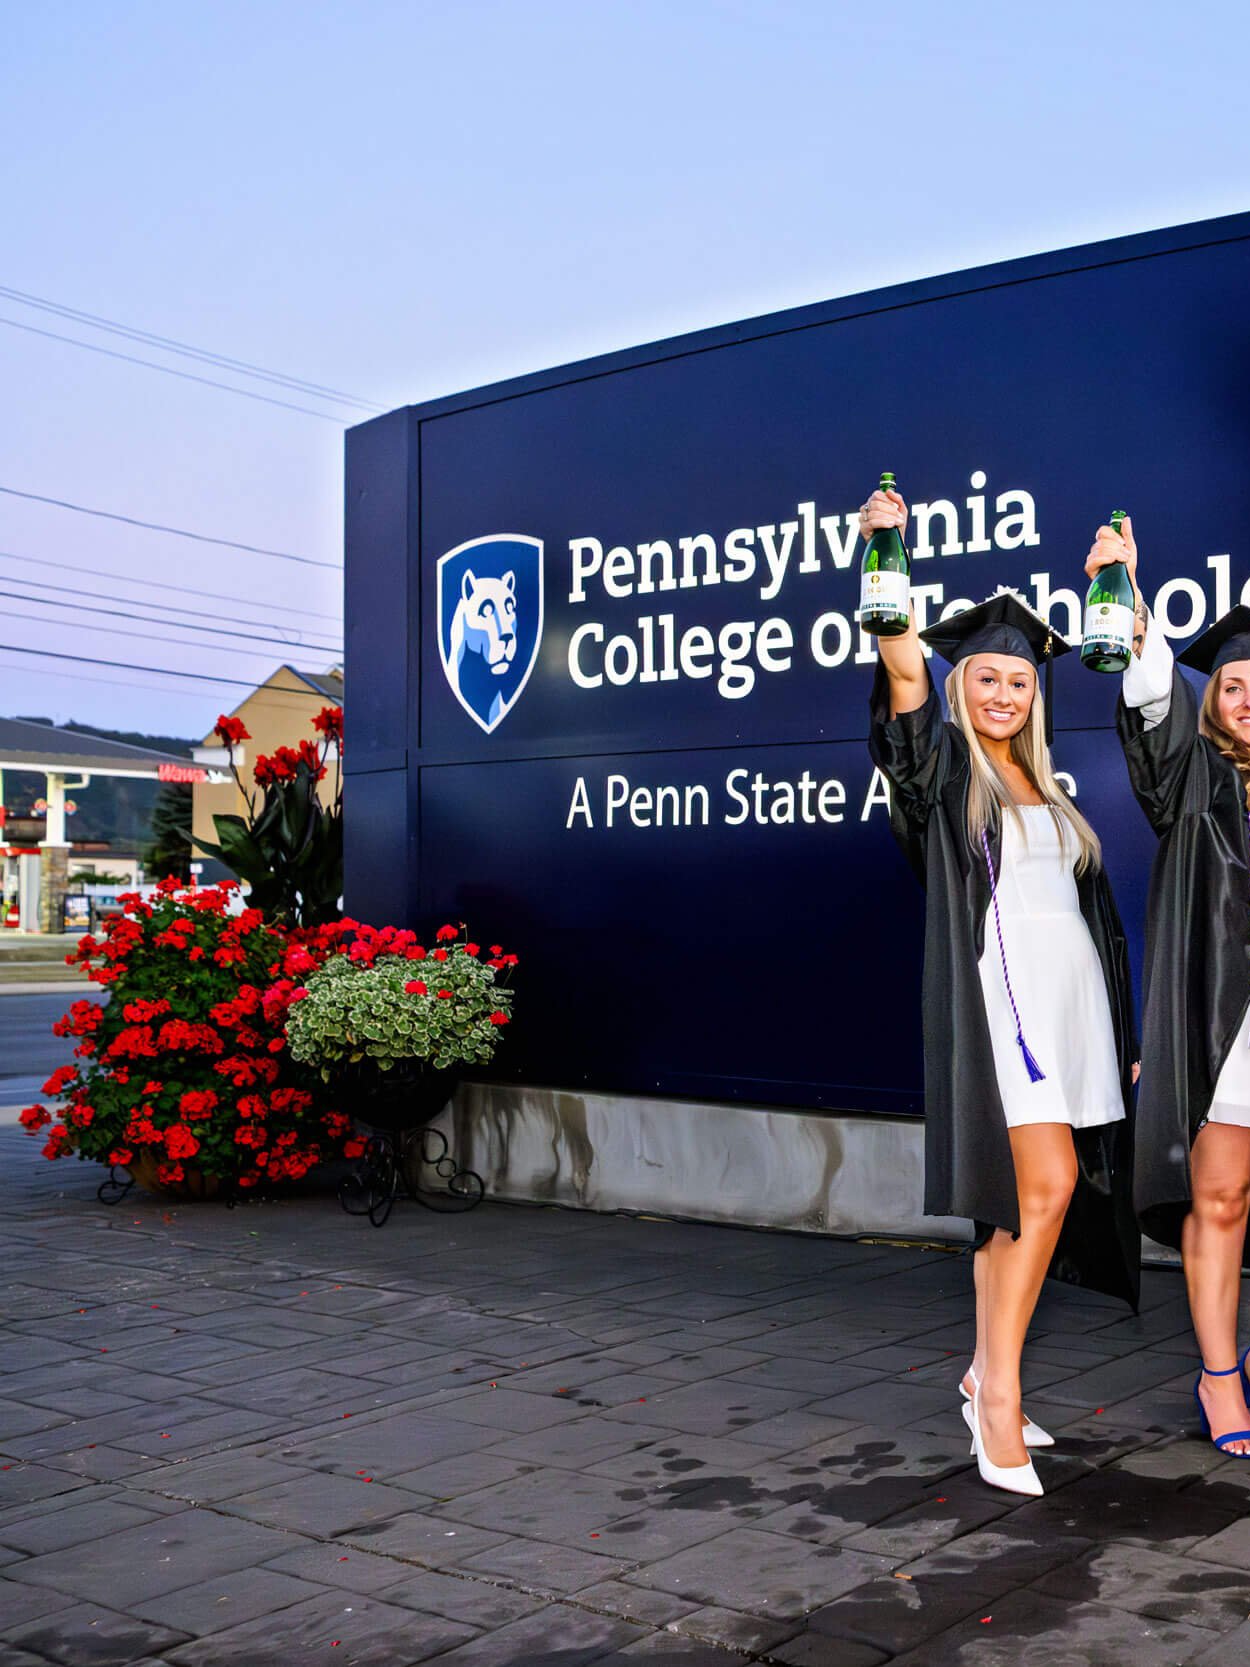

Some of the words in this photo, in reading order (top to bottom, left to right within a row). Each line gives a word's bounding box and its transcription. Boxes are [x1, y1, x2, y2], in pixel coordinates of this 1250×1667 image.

[568, 470, 1041, 602] Pennsylvnia
[567, 609, 794, 699] College
[158, 764, 207, 784] Wawa
[567, 777, 594, 829] A
[606, 774, 709, 828] Penn
[724, 768, 846, 826] State
